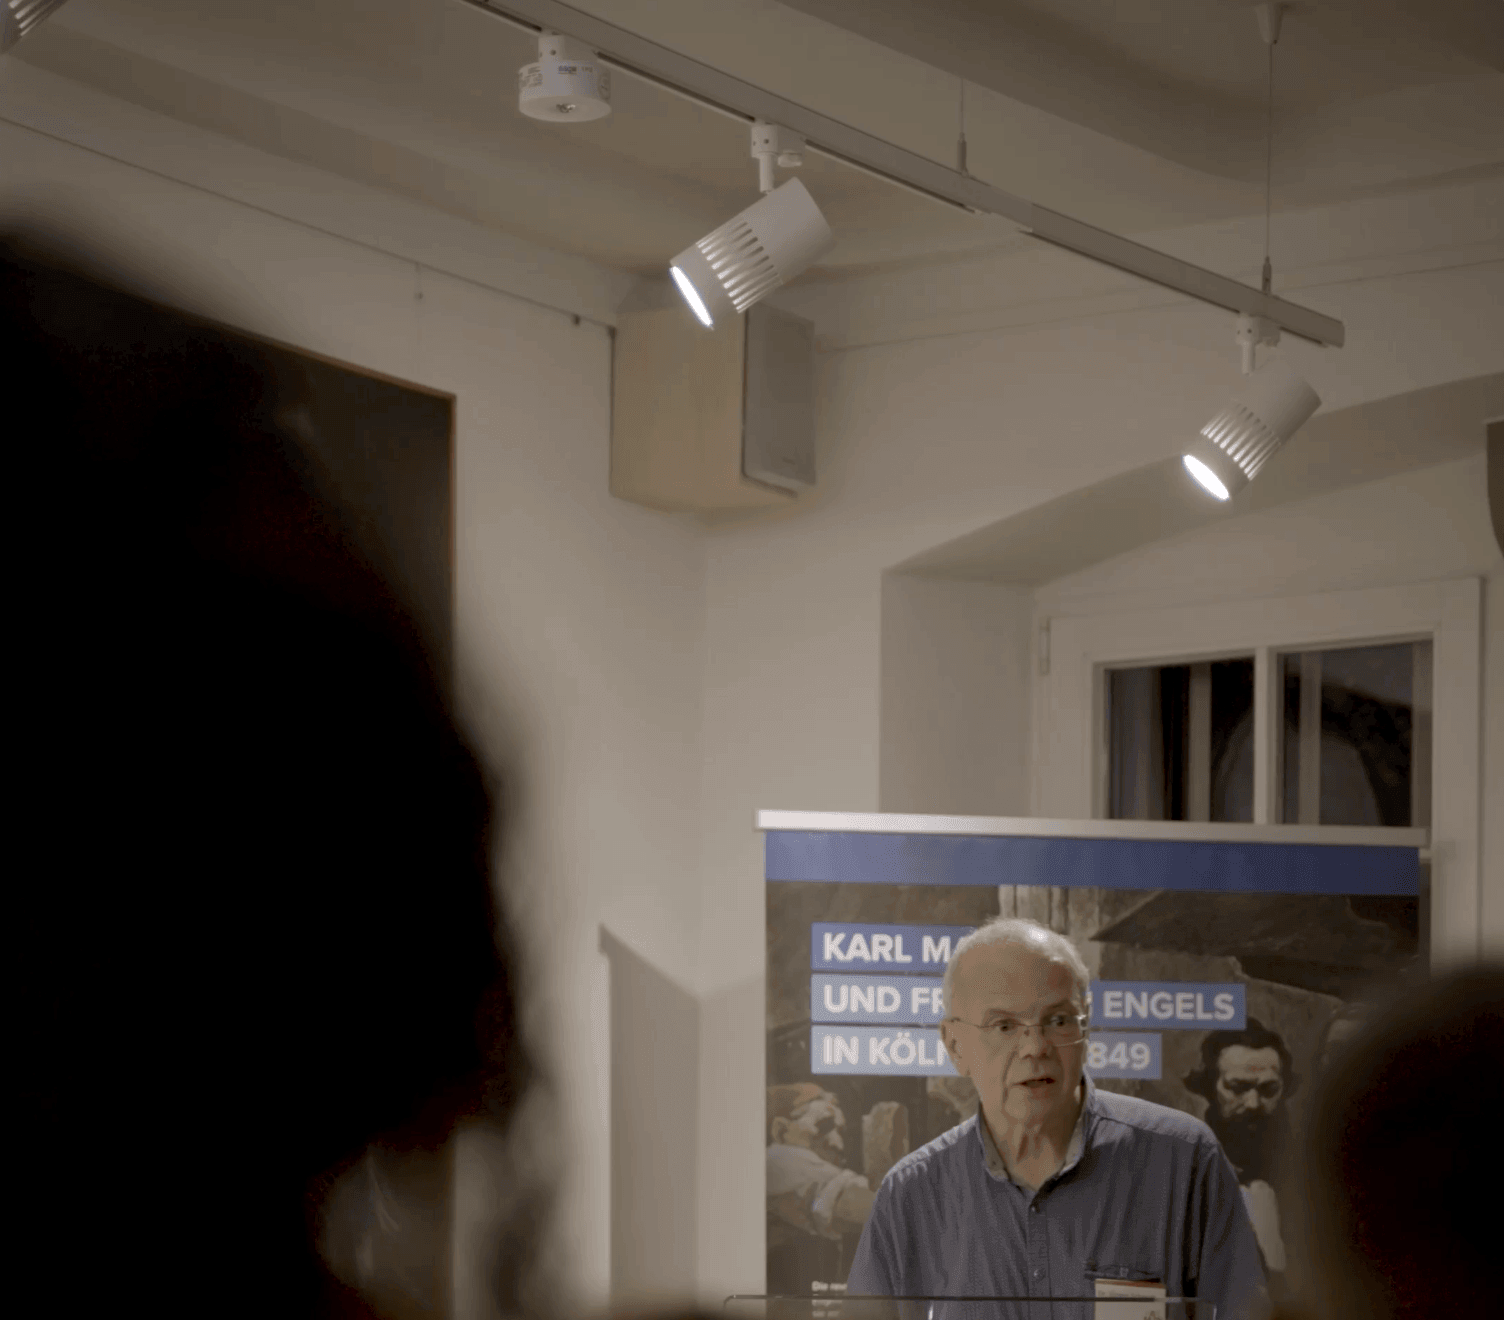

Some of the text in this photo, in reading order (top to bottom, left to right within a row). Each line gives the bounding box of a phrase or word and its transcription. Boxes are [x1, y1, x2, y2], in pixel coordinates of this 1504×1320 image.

[823, 932, 913, 963] KARL
[823, 984, 901, 1014] UND
[1103, 990, 1236, 1021] ENGELS
[823, 1035, 860, 1066] IN
[1086, 1041, 1151, 1071] 849
